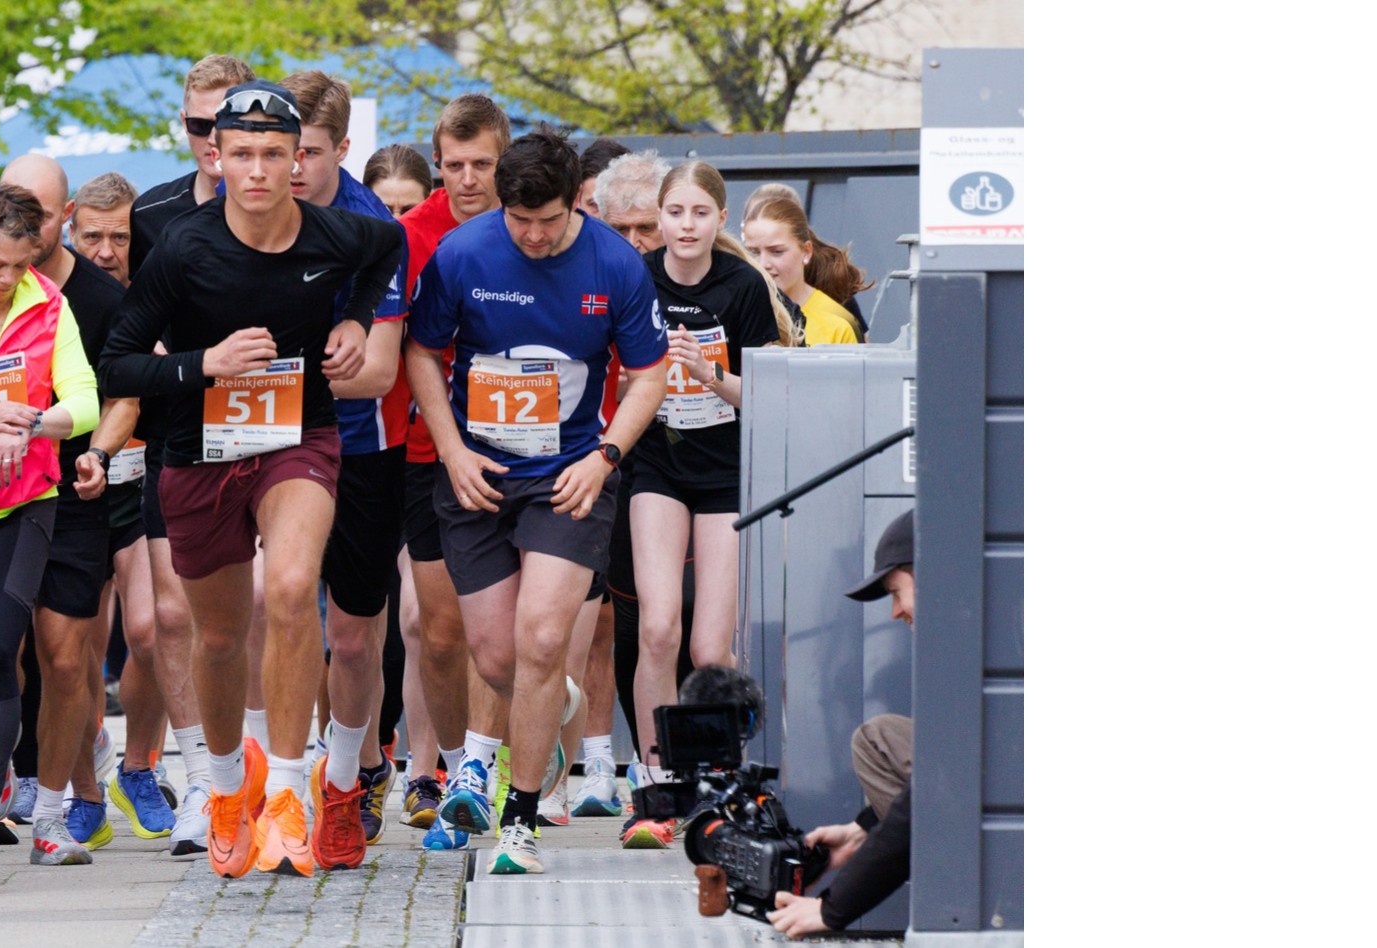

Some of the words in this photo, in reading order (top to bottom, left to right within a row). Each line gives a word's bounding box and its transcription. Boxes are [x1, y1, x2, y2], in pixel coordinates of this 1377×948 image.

[472, 288, 535, 305] Gjensidige
[667, 305, 695, 313] CRAFT
[214, 375, 297, 389] Steinkjermila
[474, 373, 552, 390] Steinkjermila
[225, 390, 275, 424] 51
[489, 390, 539, 423] 12
